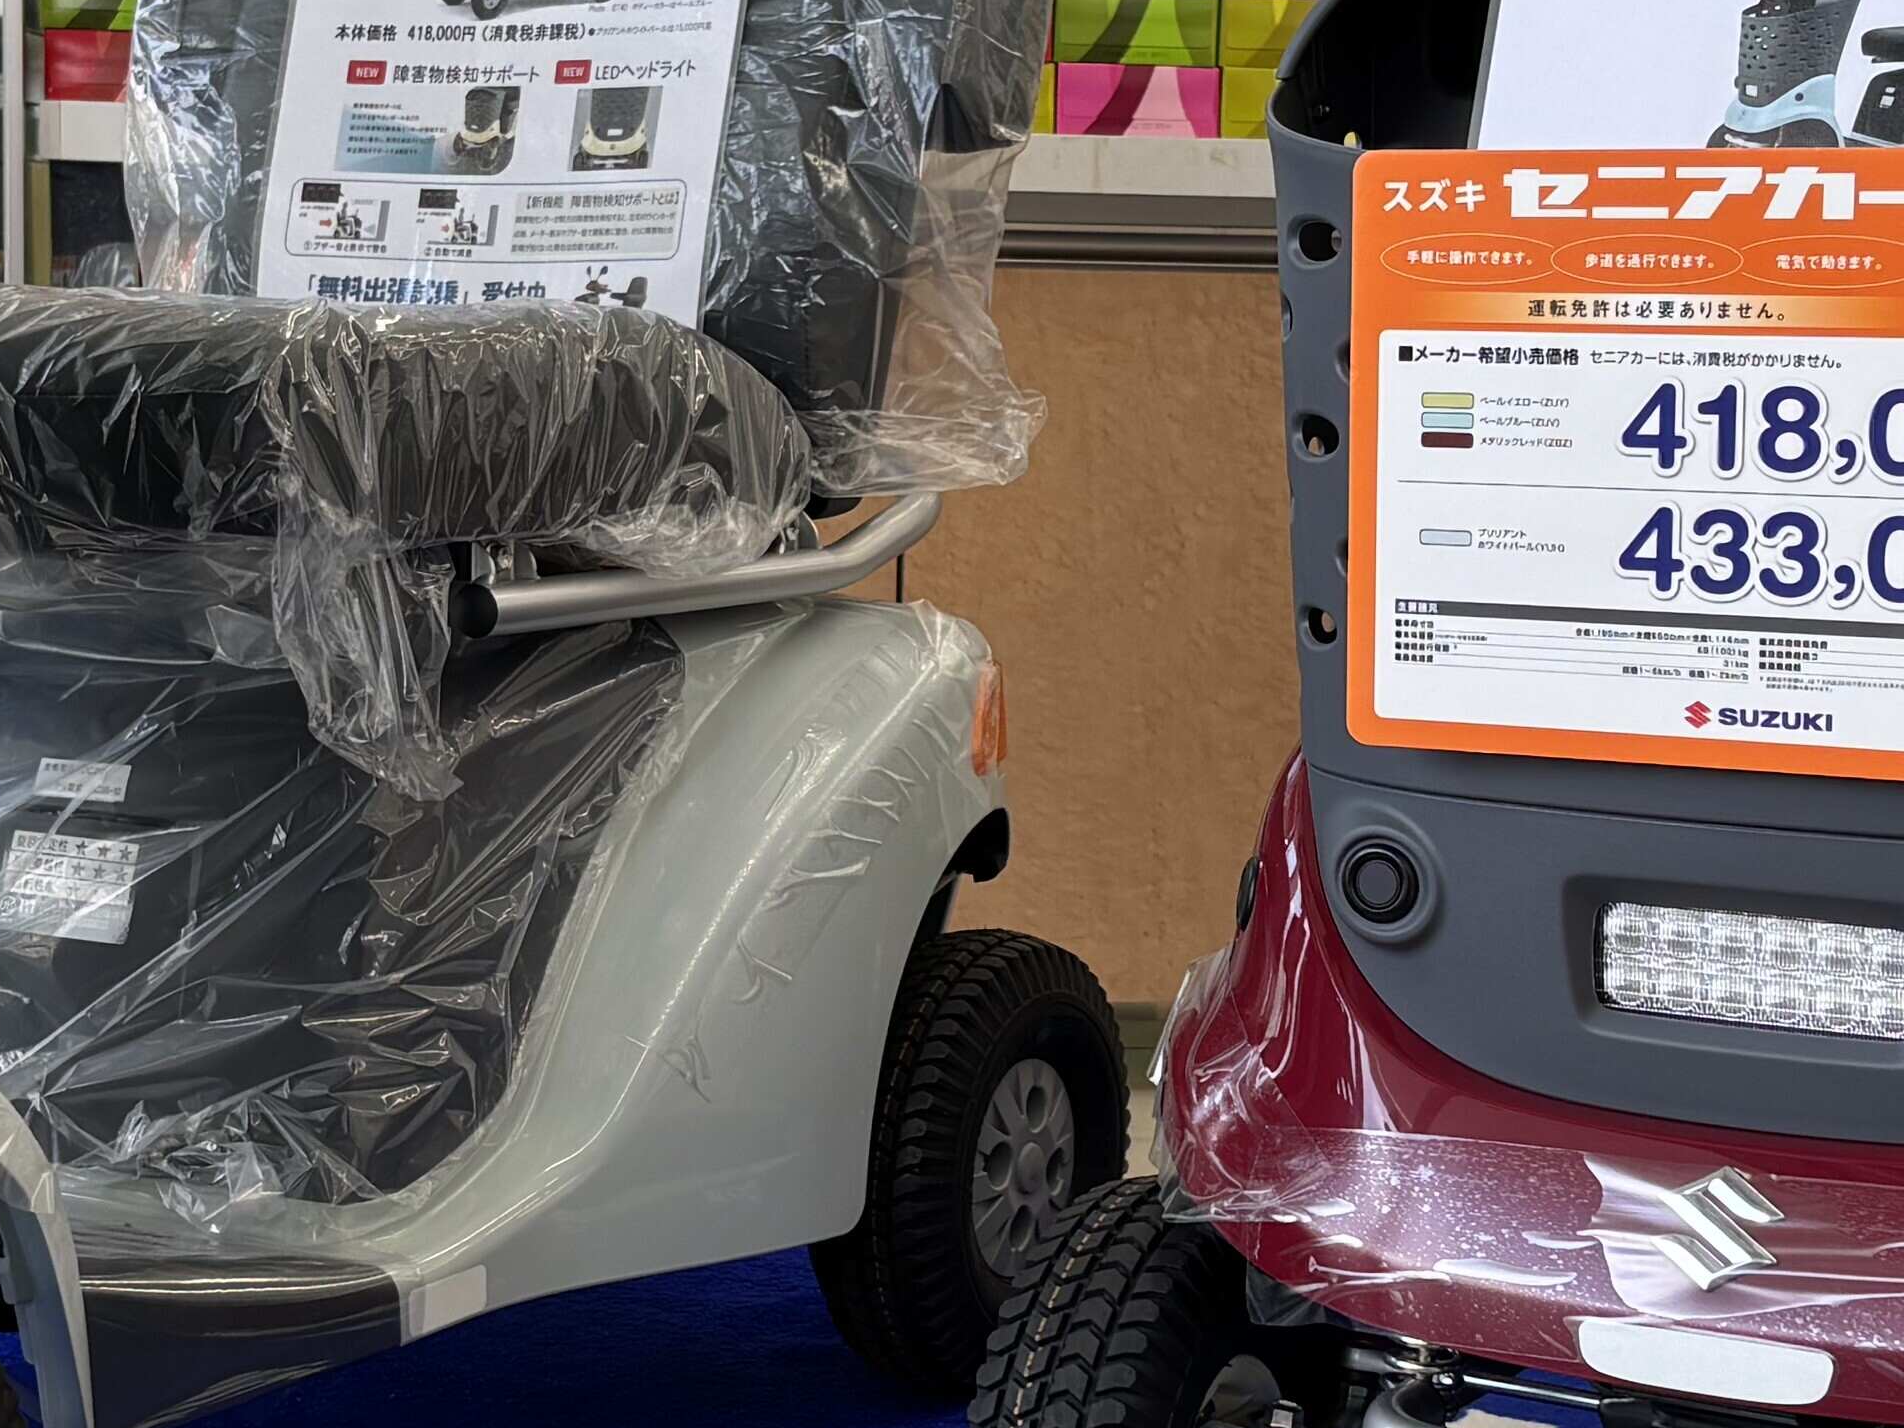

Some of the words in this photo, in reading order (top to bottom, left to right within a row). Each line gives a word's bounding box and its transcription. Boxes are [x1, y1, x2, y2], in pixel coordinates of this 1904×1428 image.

[334, 25, 397, 42] 本体価格
[407, 25, 476, 43] 418,000円
[355, 68, 379, 79] NEW
[392, 64, 540, 85] 障害物検知サポート
[562, 66, 585, 78] NEW
[594, 59, 697, 82] LEDヘッドライト
[1383, 179, 1487, 213] スズキ
[1406, 249, 1534, 267] 手軽に操作できます。
[1584, 254, 1715, 270] 歩道を通行できます。
[1775, 254, 1883, 271] 電気で動きます。
[1528, 298, 1785, 322] 運転免許は必要ありません。
[1414, 346, 1580, 365] メーカー希望小売価格
[1590, 350, 1844, 369] セニアカーには、消費税がかかりません。
[1718, 706, 1833, 733] SUZUKI
